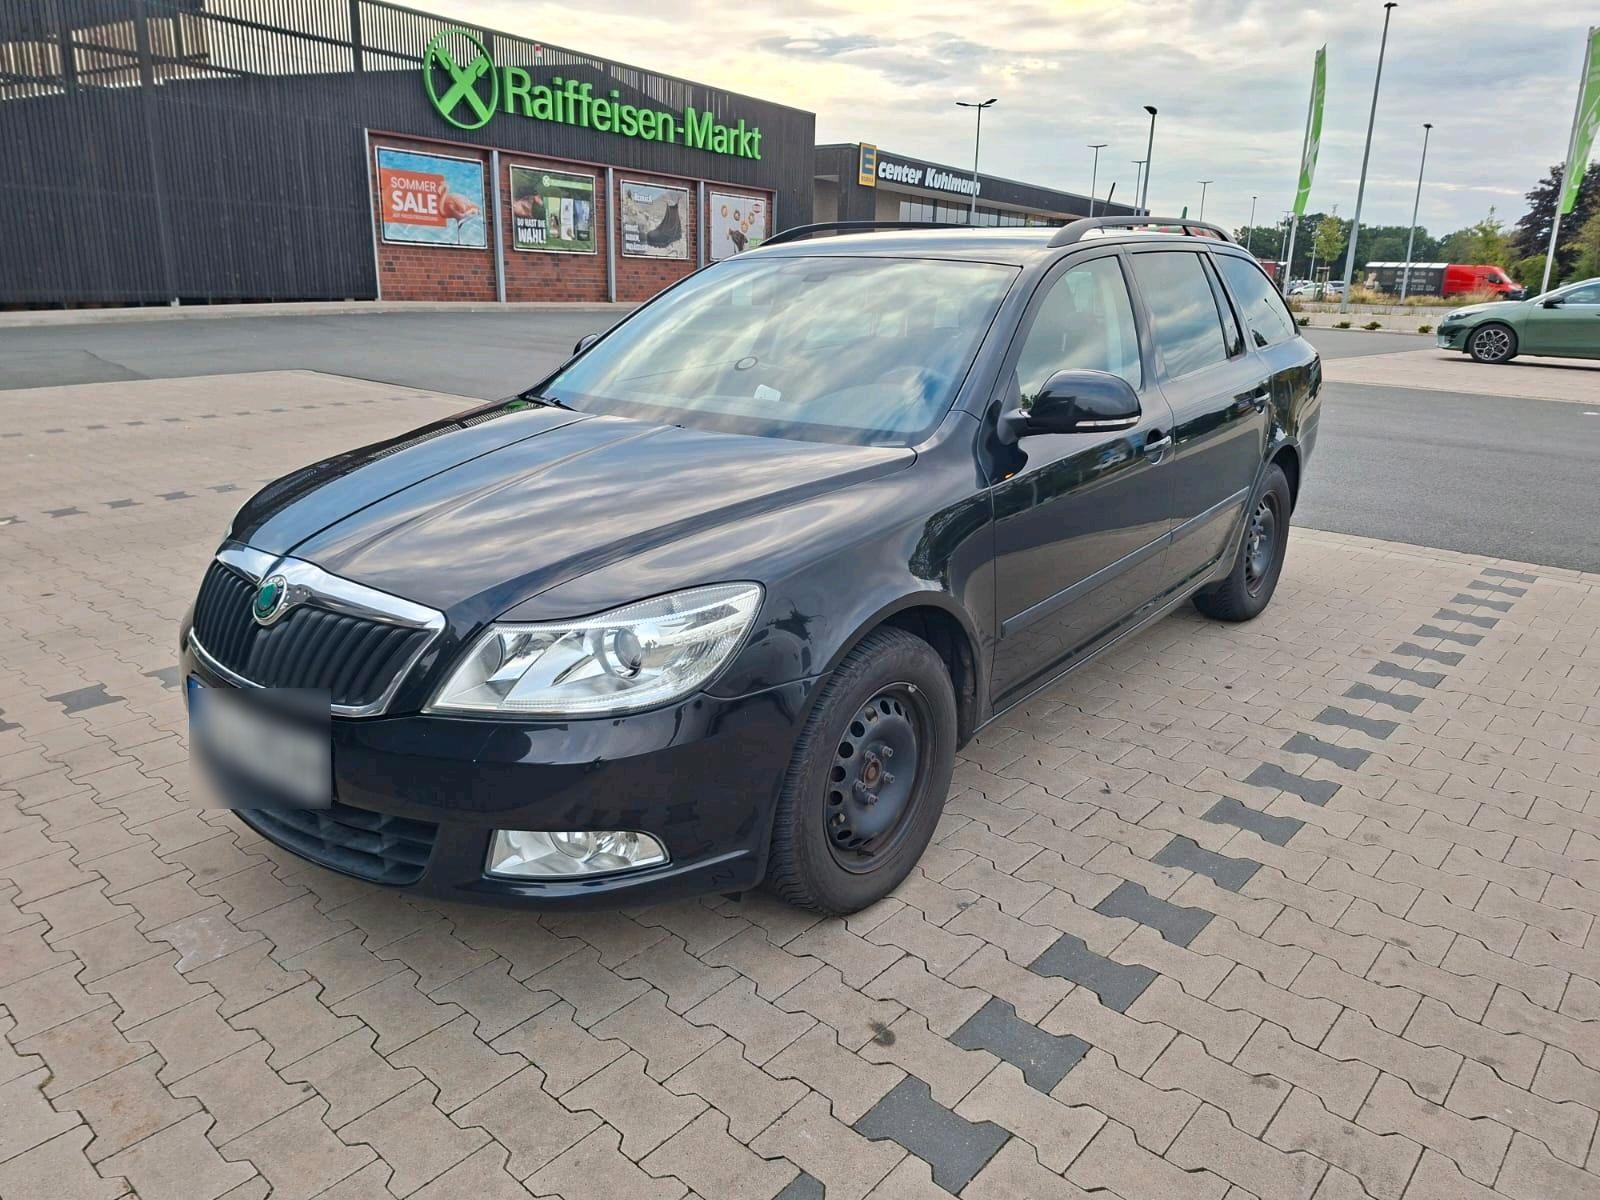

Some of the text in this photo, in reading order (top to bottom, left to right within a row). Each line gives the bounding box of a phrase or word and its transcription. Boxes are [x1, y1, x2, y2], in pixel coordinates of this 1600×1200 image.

[504, 65, 762, 160] Raiffeisen-Markt
[390, 176, 437, 193] SOMMER
[878, 161, 923, 185] center
[924, 167, 981, 195] Kuhlmann
[391, 190, 438, 215] SALE
[517, 227, 547, 244] WAHL!
